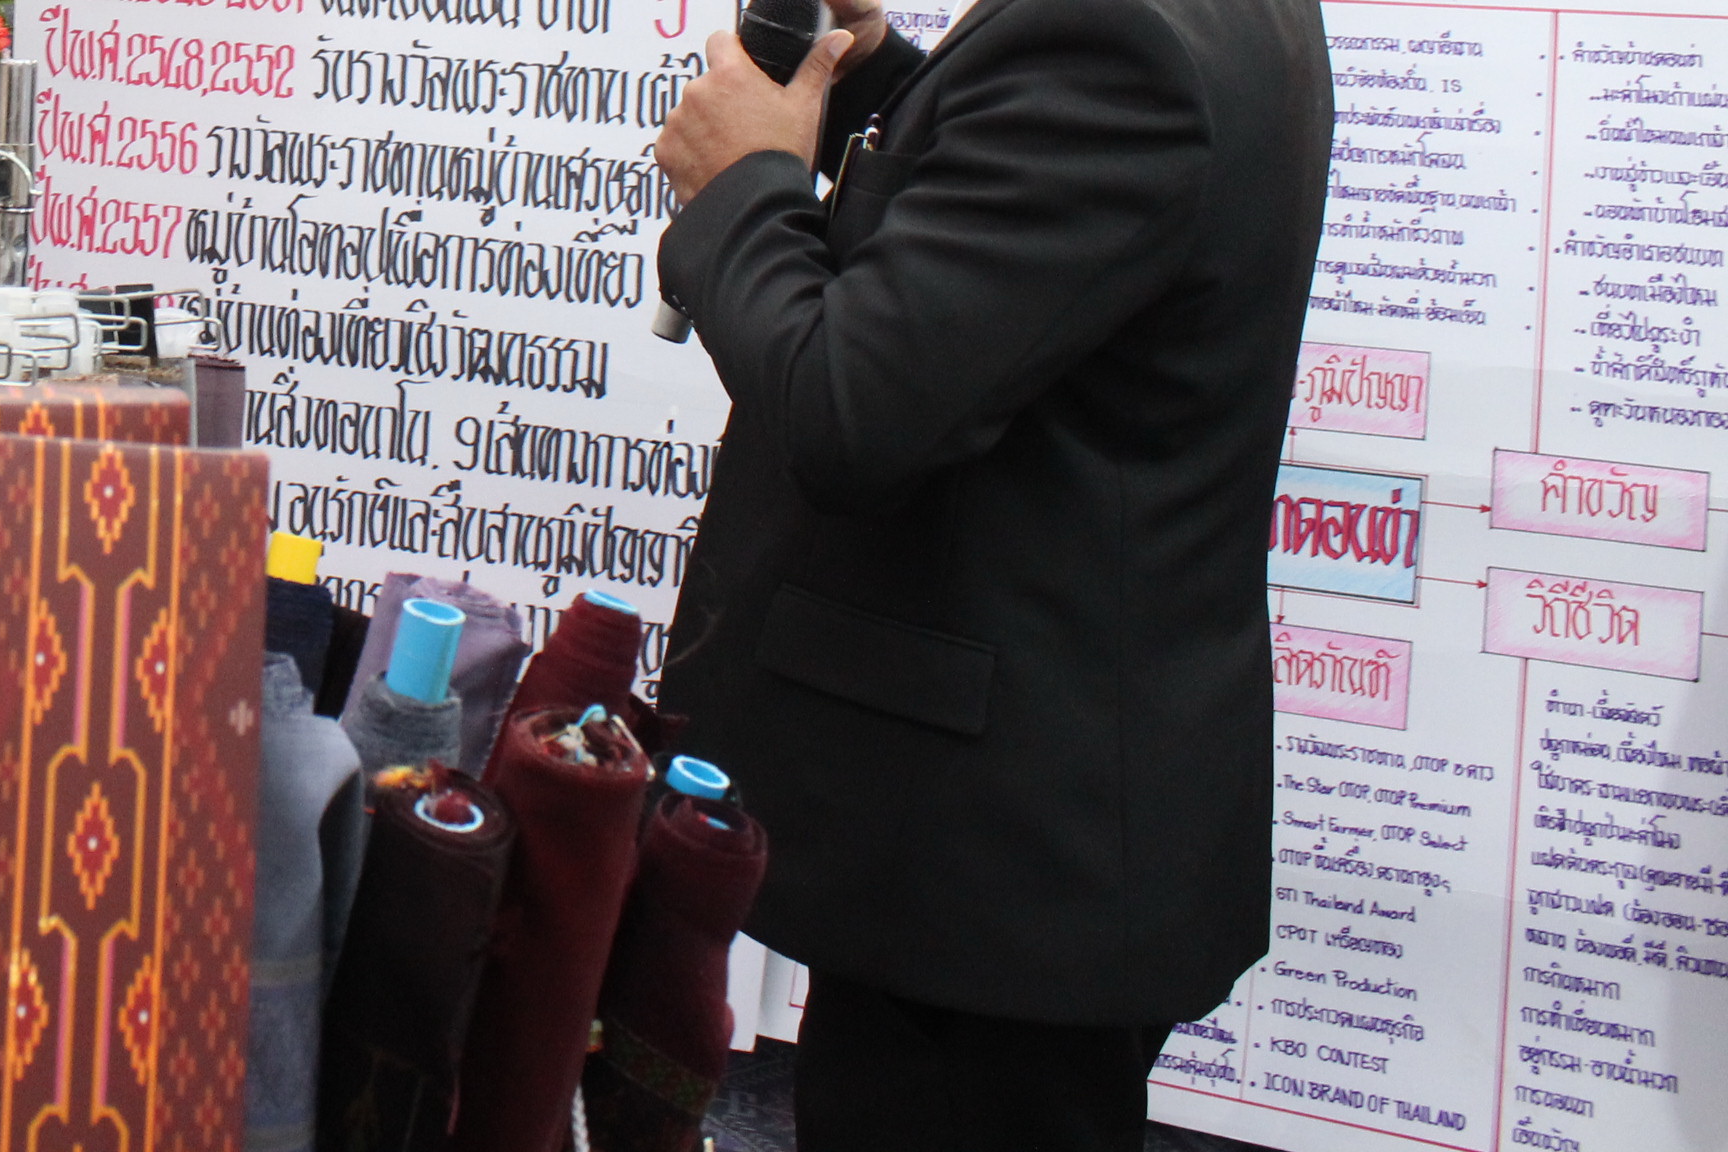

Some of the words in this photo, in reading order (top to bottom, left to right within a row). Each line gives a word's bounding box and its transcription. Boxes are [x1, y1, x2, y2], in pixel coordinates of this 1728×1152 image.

[1441, 79, 1463, 93] IS
[1540, 460, 1659, 523] คำขวัญ
[1283, 774, 1305, 792] The
[1306, 776, 1336, 795] Star
[1374, 787, 1408, 807] OTOP
[1282, 810, 1326, 832] Smart
[1380, 824, 1416, 844] OTOP
[1419, 830, 1469, 852] Select
[1279, 848, 1312, 866] OTOP
[1301, 890, 1365, 915] Thailand
[1369, 900, 1417, 923] Award
[1276, 924, 1319, 944] CPOT
[1274, 960, 1327, 984] Green
[1331, 969, 1417, 1002] Production
[1270, 1036, 1307, 1059] KBO
[1317, 1045, 1390, 1074] CONTEST
[1263, 1071, 1305, 1098] ICON
[1306, 1081, 1364, 1109] BRAND
[1367, 1093, 1390, 1114] OF
[1391, 1097, 1467, 1132] THAILAND
